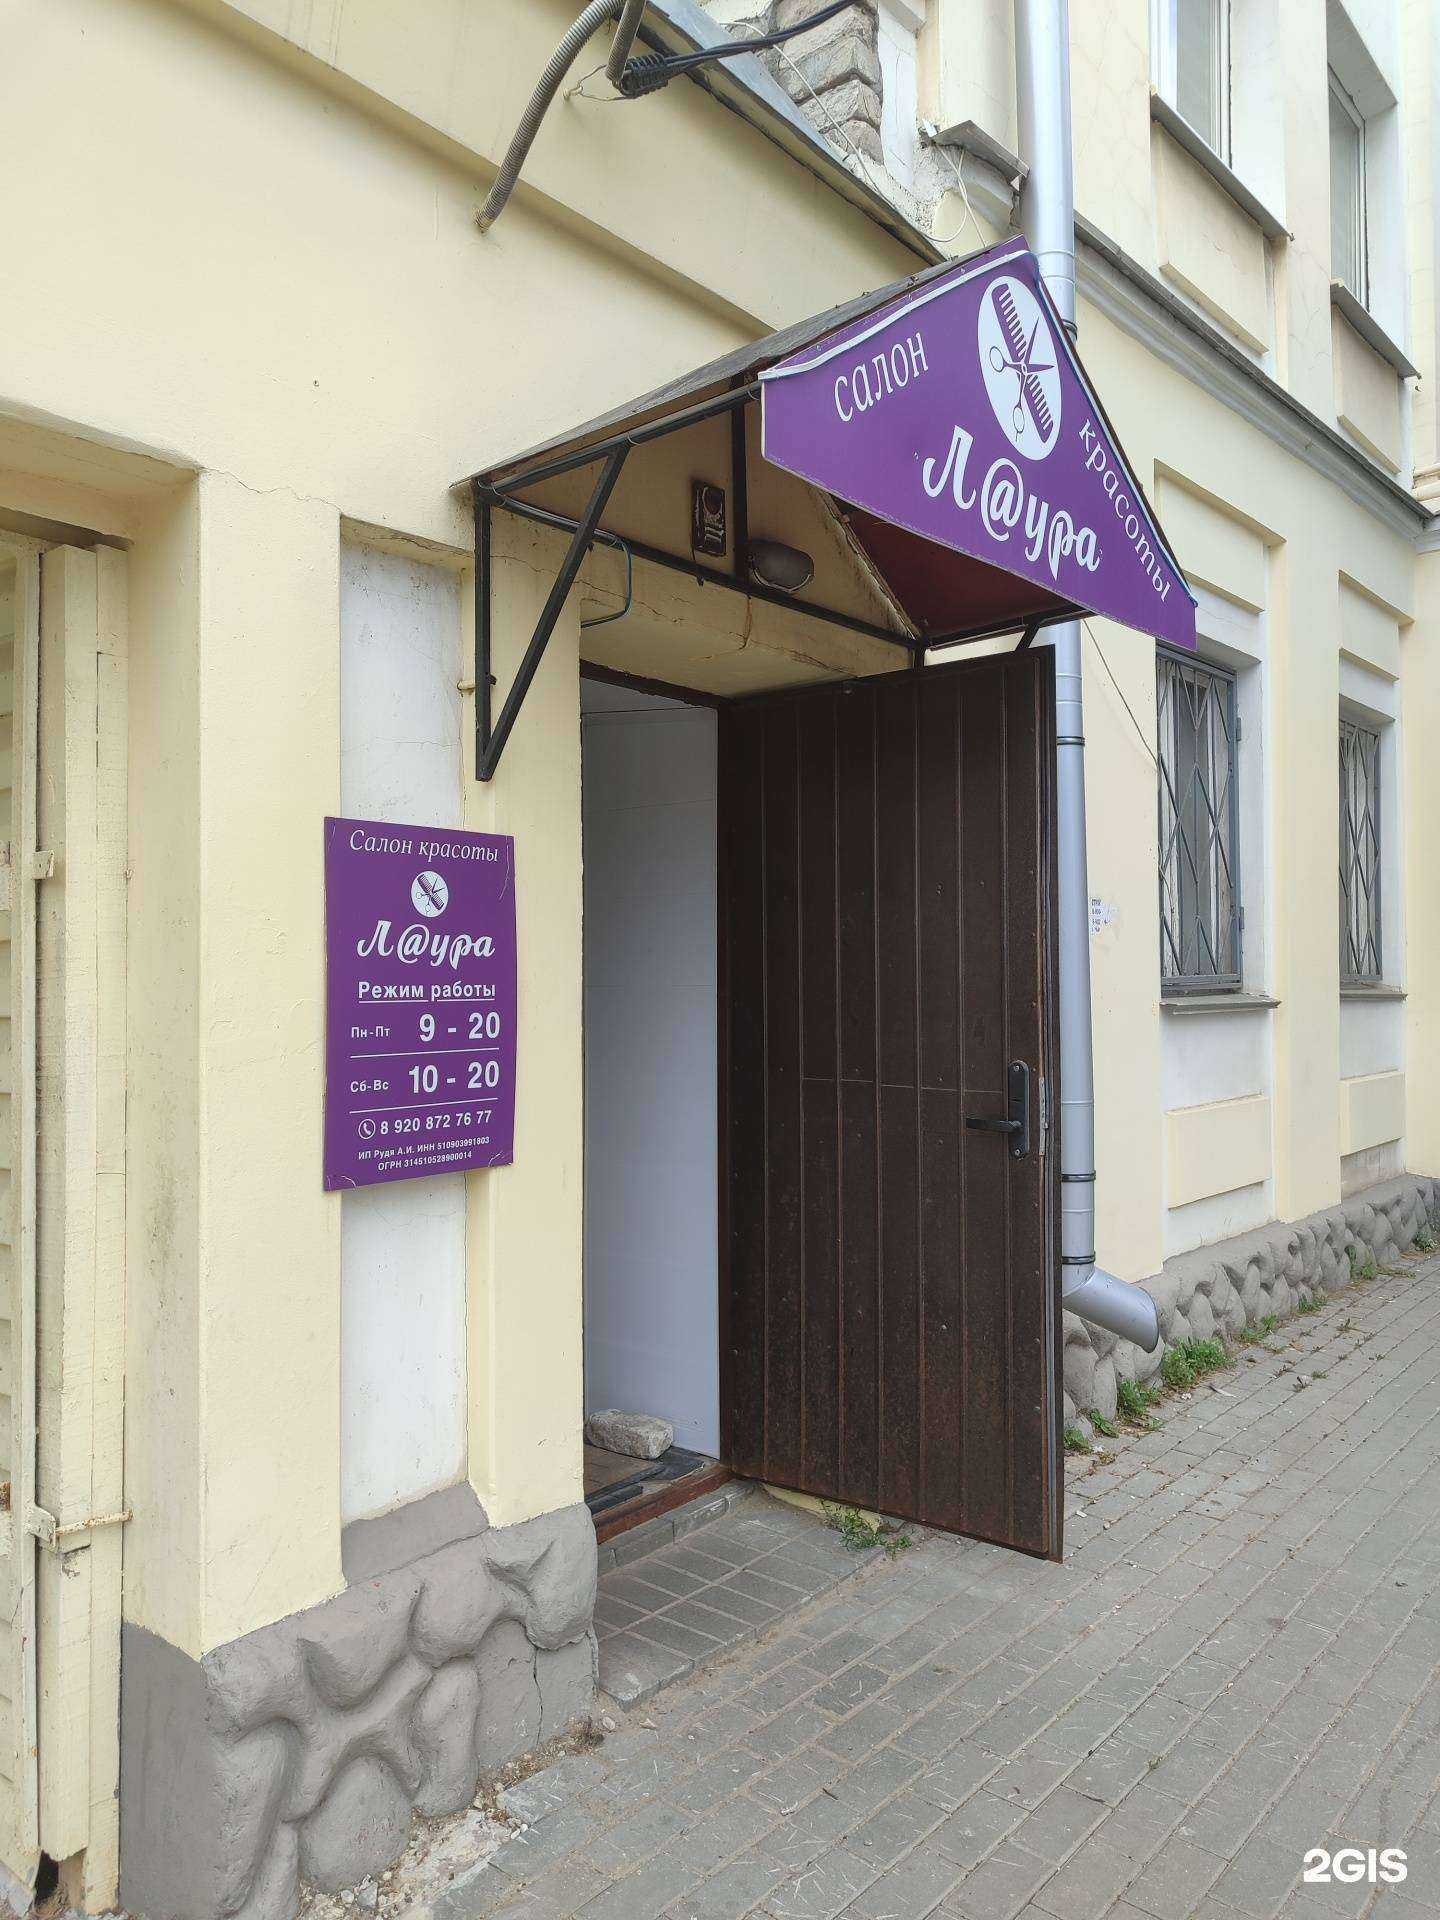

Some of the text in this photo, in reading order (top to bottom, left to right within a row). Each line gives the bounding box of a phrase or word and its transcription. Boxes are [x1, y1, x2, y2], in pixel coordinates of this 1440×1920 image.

[833, 332, 929, 422] салон
[922, 424, 1101, 581] Л@ура
[1078, 419, 1171, 602] красоты
[350, 829, 499, 862] Салон красоты
[356, 919, 496, 970] Л@ура
[358, 980, 496, 1002] Режим работы
[351, 1025, 391, 1038] Пн-Пт
[419, 1013, 435, 1042] 9
[468, 1011, 501, 1040] 20
[350, 1079, 389, 1093] Сб-Вс
[408, 1064, 438, 1094] 10
[467, 1060, 500, 1089] 20
[380, 1109, 492, 1135] 8 920 872 76 77
[358, 1136, 490, 1160] ИП Рудя А.И. ИНН 510903991803
[378, 1150, 472, 1171] ОГРН 314510528900014
